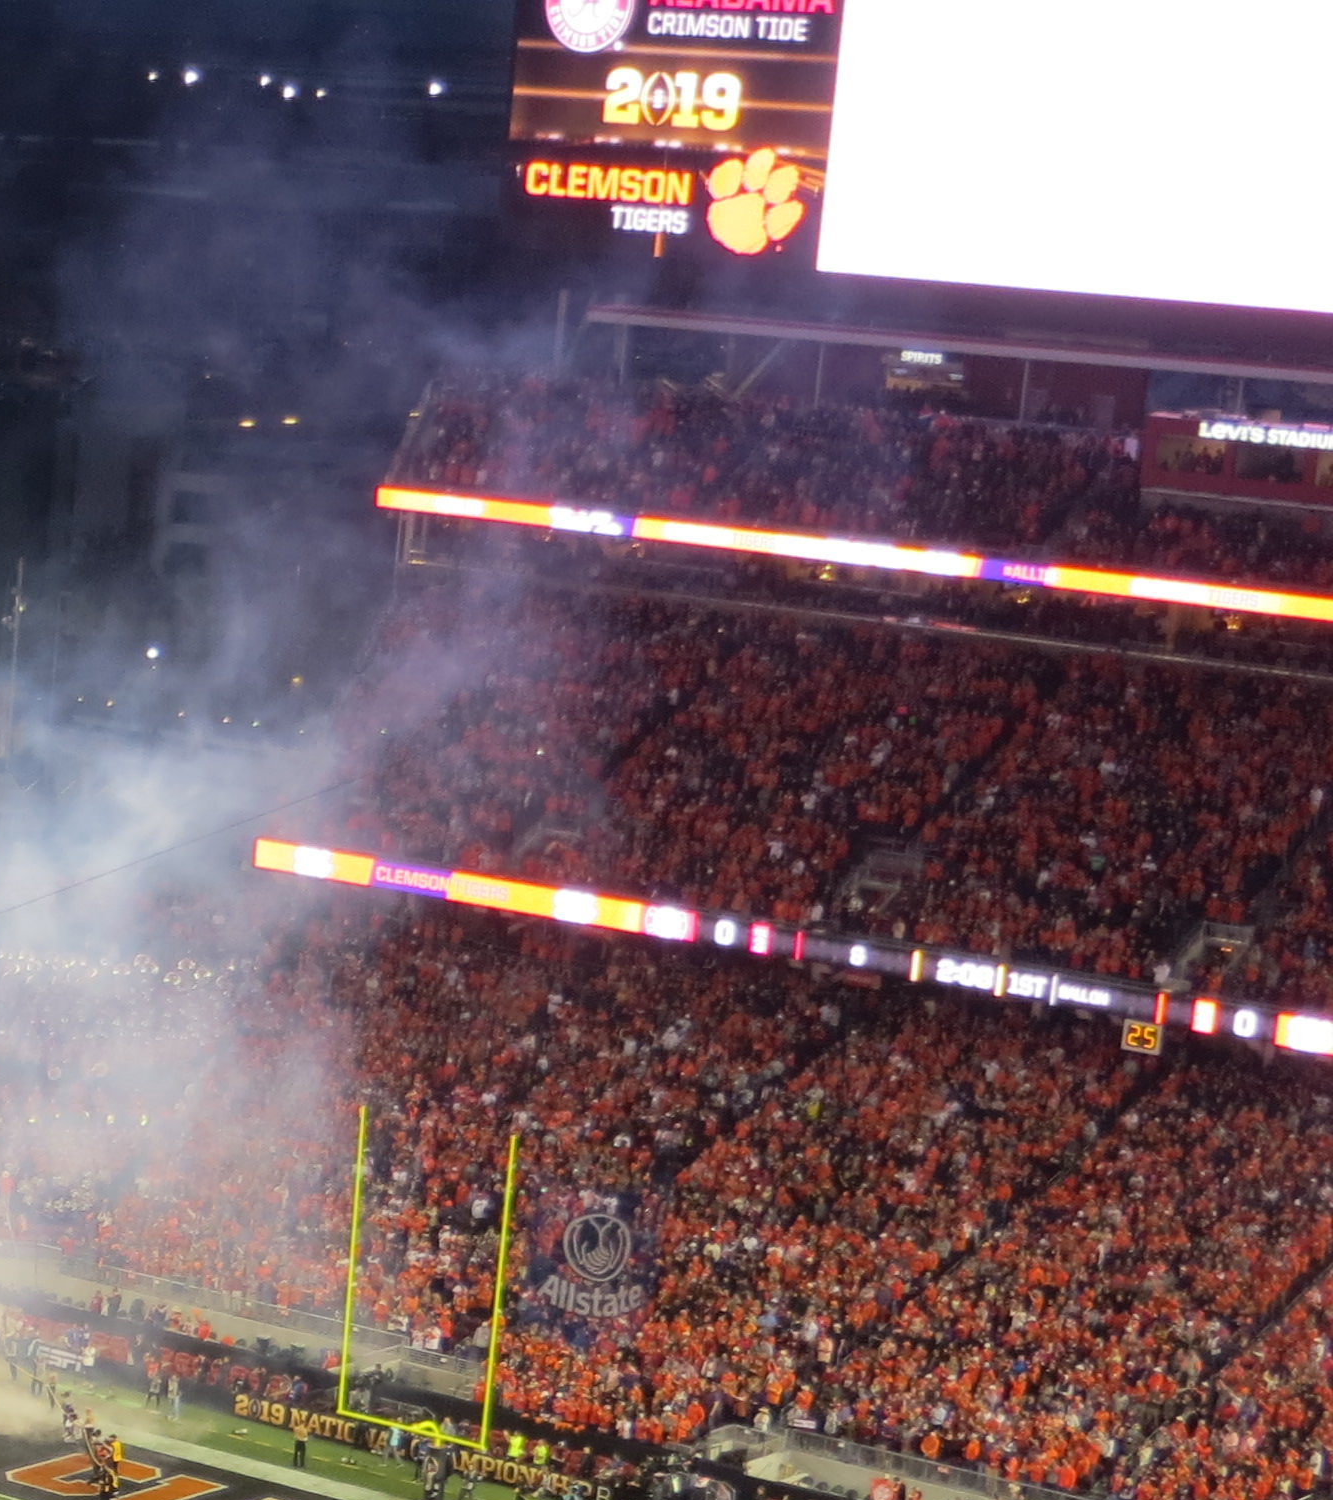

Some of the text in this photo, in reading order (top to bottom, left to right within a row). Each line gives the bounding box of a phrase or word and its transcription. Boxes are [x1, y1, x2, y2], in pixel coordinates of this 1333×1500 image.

[648, 12, 809, 41] CRIMSON TIDE
[525, 163, 691, 205] CLEMSON
[612, 206, 688, 234] TIGERS
[901, 350, 942, 365] SPIRITS
[1267, 429, 1333, 450] STADIU
[733, 533, 776, 550] TIGERS
[1208, 589, 1259, 608] TIGERS
[376, 866, 507, 901] CLEMSON TIGERS
[1007, 971, 1048, 999] 1ST
[1126, 1024, 1156, 1050] 25
[537, 1275, 642, 1317] Allstate
